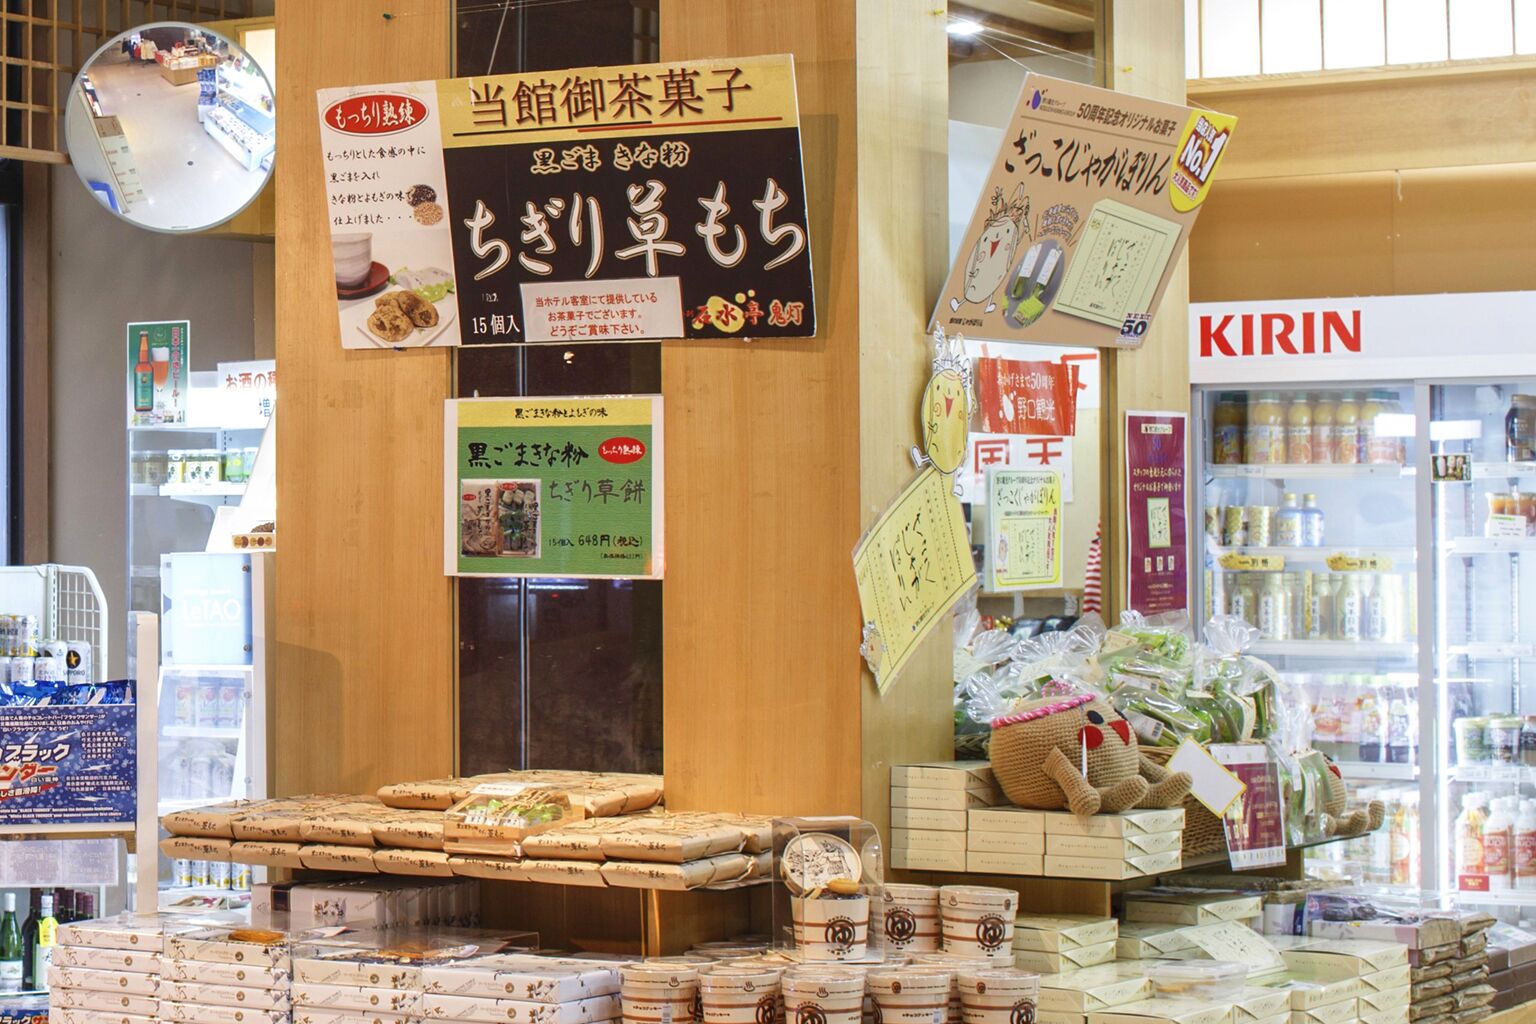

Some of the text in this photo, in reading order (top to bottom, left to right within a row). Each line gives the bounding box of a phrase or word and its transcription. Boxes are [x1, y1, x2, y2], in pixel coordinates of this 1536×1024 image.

[471, 68, 753, 127] 当館御茶菓子
[334, 100, 416, 129] もっちり熟練
[1076, 102, 1178, 137] 50周年記念オリジナルお菓子
[327, 145, 426, 162] もっちりとした食感の中に
[530, 140, 690, 174] 黒ごま きな粉
[464, 178, 804, 281] ちぎり草もち
[535, 291, 658, 309] 当ホテル客室にて提供している
[471, 314, 520, 335] 15個入
[547, 309, 643, 324] お茶菓子でございます。
[550, 322, 646, 339] どうぞご賞味下さい。
[1199, 310, 1362, 357] KIRIN
[515, 408, 608, 419] 黒ごまきな粉とよもぎの味
[468, 441, 590, 469] 黒ごまきな粉
[548, 479, 646, 504] ちぎり草餅
